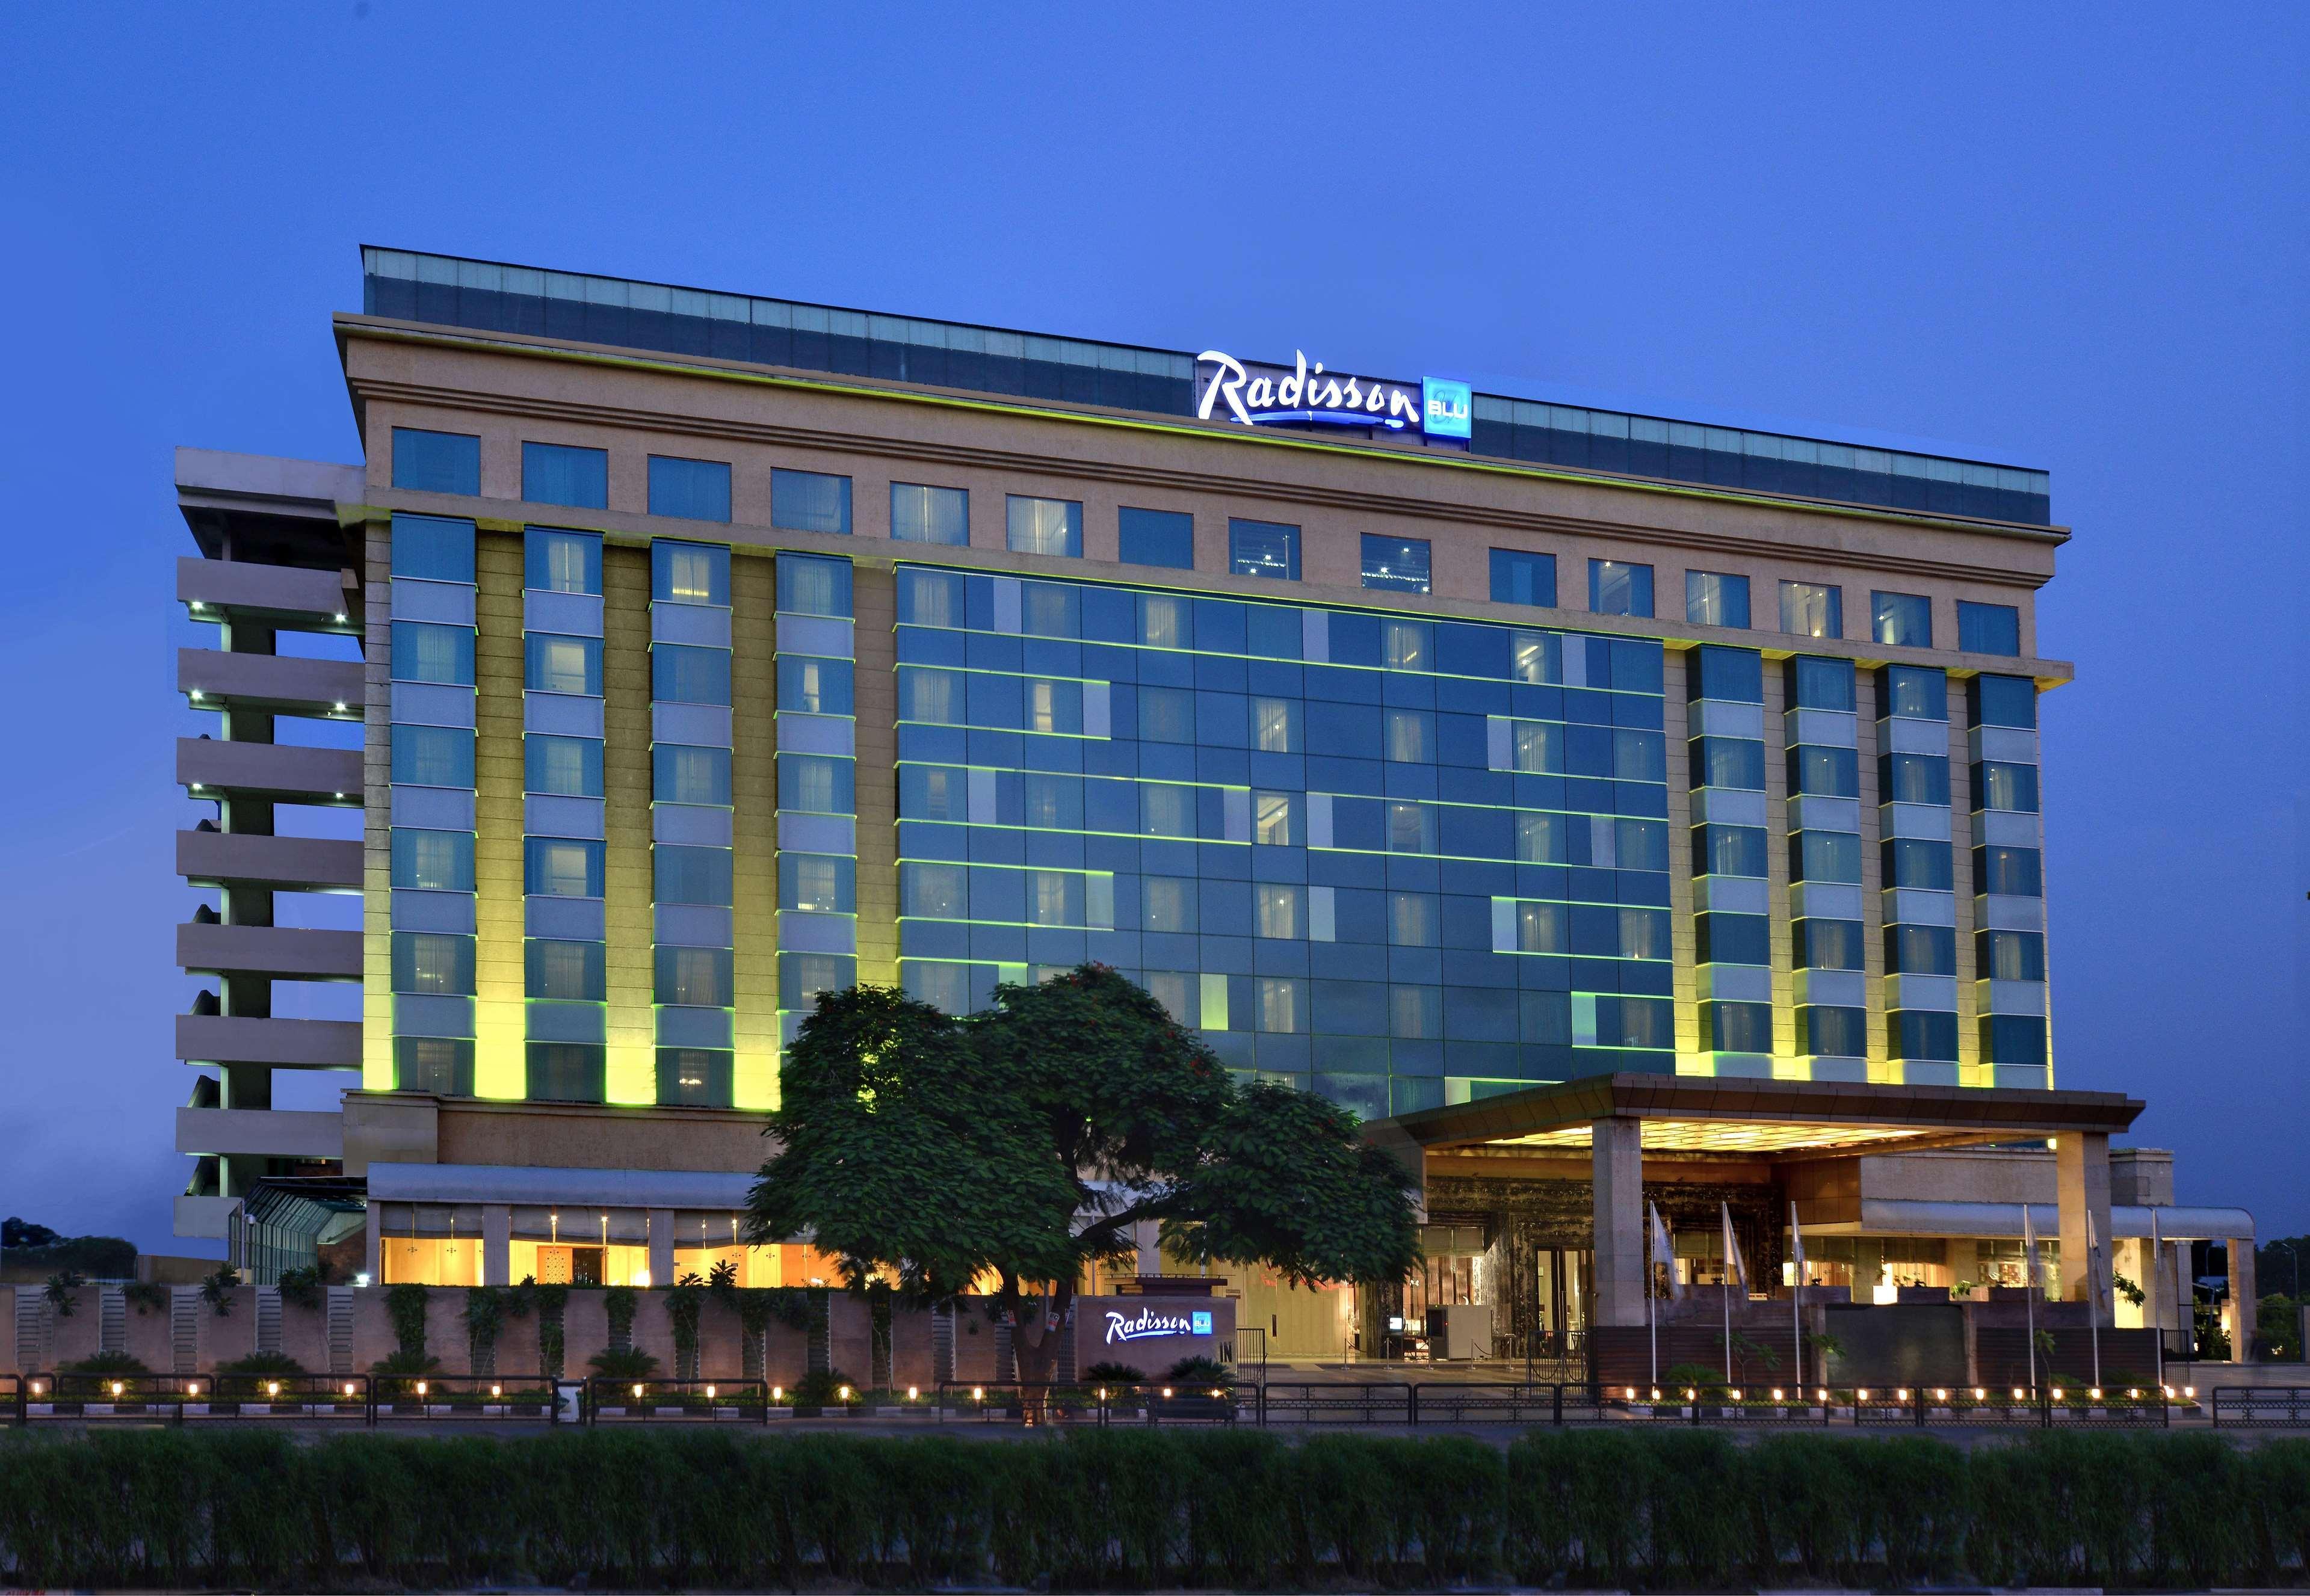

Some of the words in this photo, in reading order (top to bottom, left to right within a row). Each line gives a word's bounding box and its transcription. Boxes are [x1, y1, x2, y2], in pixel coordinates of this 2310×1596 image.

[1197, 348, 1420, 427] Radisson
[1428, 399, 1468, 419] BLU
[1105, 1307, 1191, 1345] Radisson
[1220, 1342, 1232, 1363] IN
